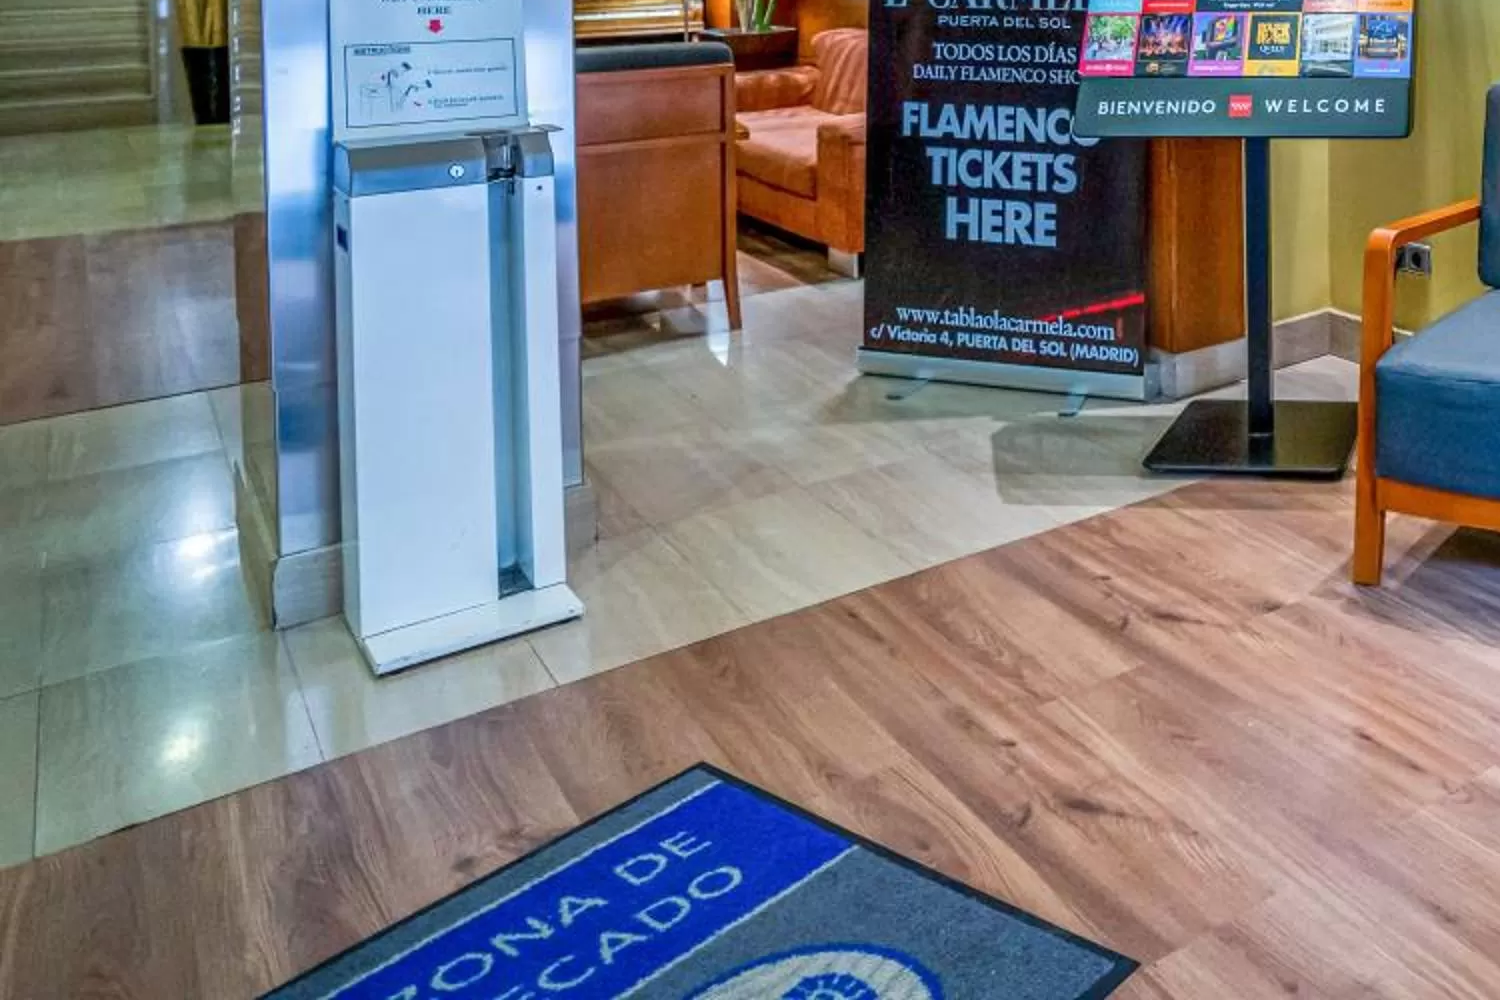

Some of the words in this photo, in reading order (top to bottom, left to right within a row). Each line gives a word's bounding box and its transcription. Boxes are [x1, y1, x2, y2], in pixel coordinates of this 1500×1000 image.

[417, 6, 452, 15] HERE
[937, 15, 999, 28] PUERTA
[1003, 16, 1035, 29] DEL
[1038, 17, 1072, 29] SOL
[932, 41, 995, 61] TODOS
[998, 43, 1031, 62] LOS
[1034, 41, 1078, 64] DÍAS
[912, 63, 958, 81] DAILY
[959, 65, 1046, 83] FLAMENCO
[1049, 68, 1081, 85] SHO
[902, 100, 1100, 147] FLAMENC
[1096, 100, 1216, 115] BIENVENIDO
[1265, 98, 1386, 114] WELCOME
[925, 145, 1077, 193] TICKETS
[945, 196, 1057, 247] HERE
[896, 306, 1115, 341] www.tablaolacarmela.com
[886, 325, 937, 342] Victoria
[956, 332, 1008, 351] PUERTA
[1011, 337, 1037, 354] DEL
[1039, 340, 1067, 357] SOL
[1069, 341, 1139, 367] (MADRID)
[614, 831, 713, 886] DE
